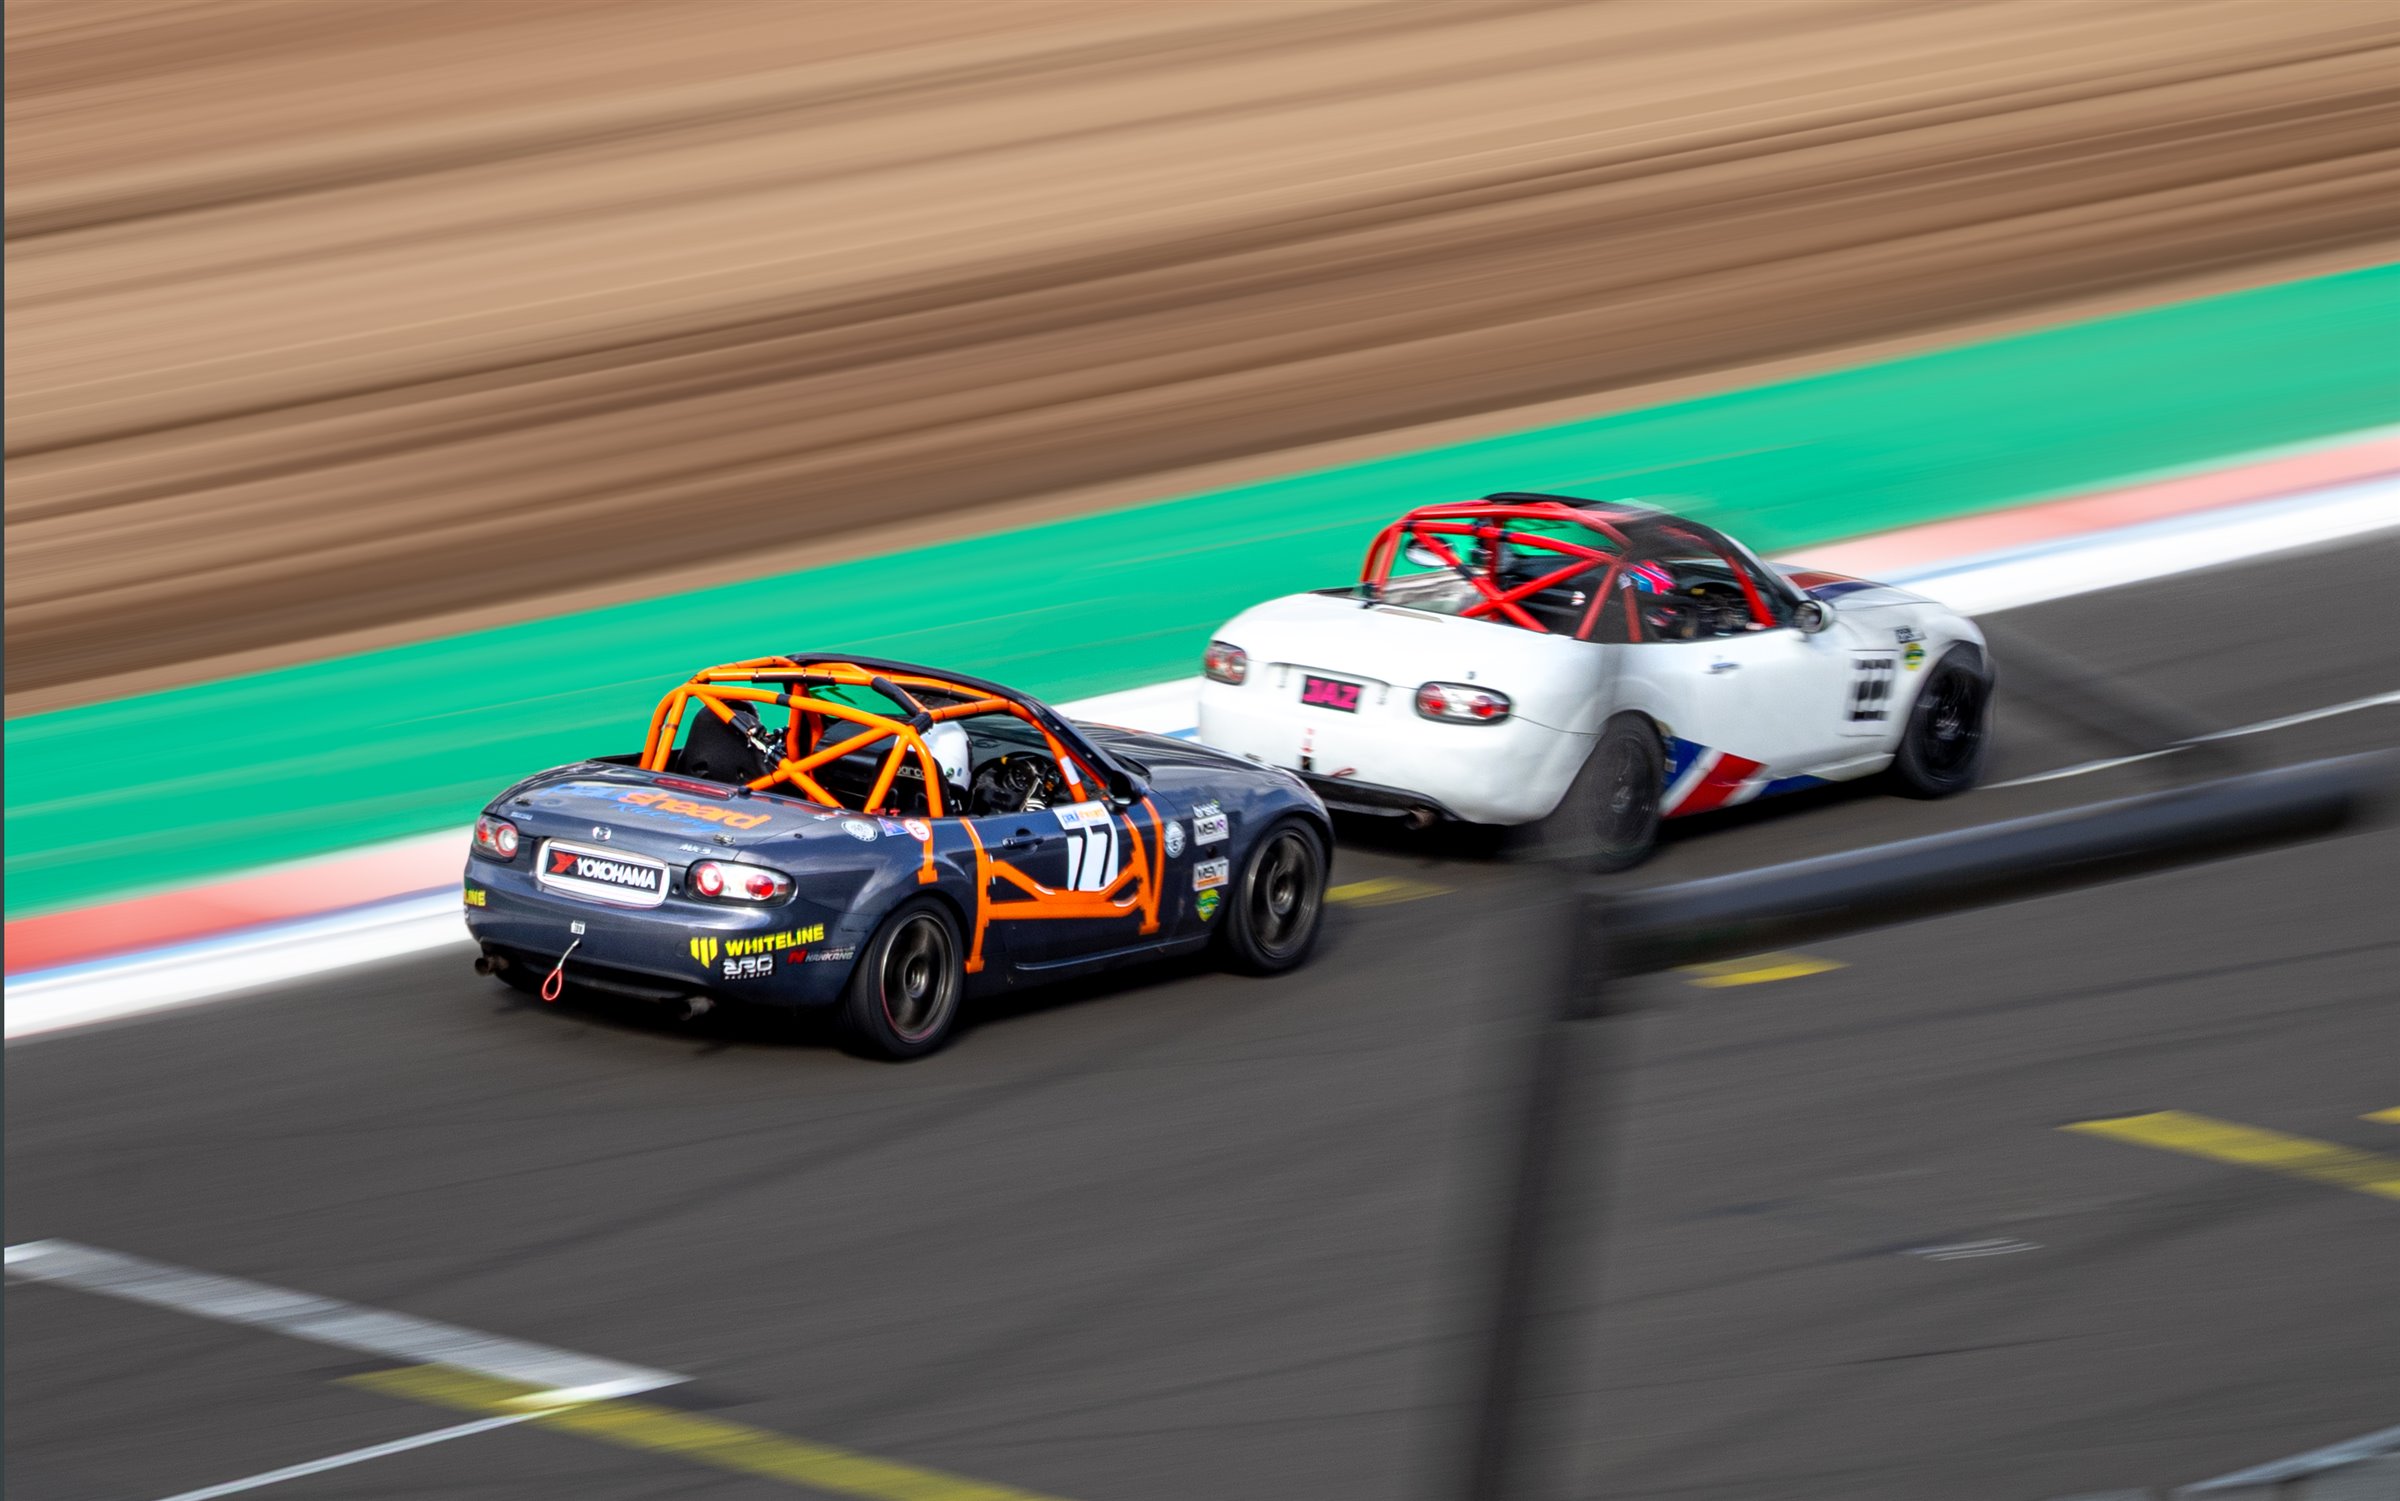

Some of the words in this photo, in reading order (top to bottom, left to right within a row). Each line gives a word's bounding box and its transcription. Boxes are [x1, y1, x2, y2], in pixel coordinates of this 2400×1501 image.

[1303, 679, 1361, 709] JAZ
[617, 792, 772, 830] sheard
[576, 856, 656, 890] YOKOHAMA
[1065, 823, 1112, 891] 77
[725, 923, 825, 957] WHITELINE
